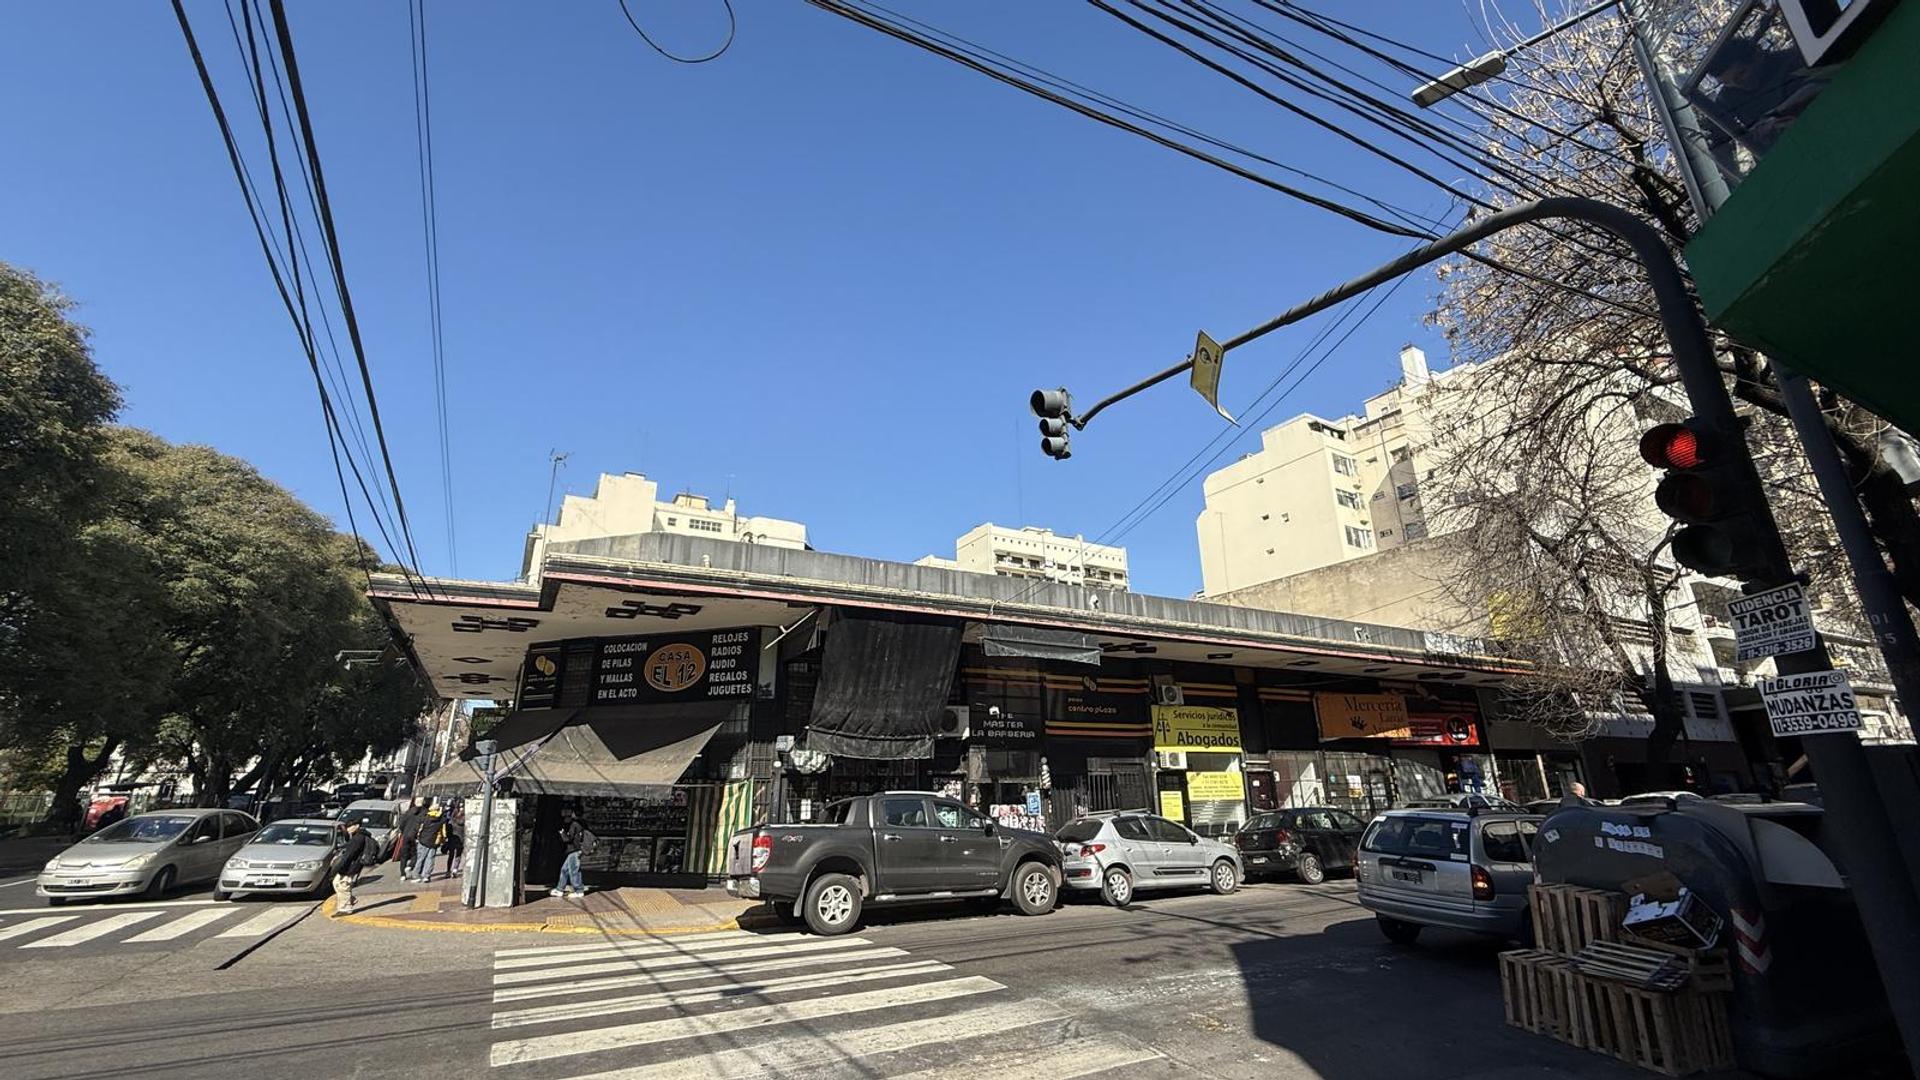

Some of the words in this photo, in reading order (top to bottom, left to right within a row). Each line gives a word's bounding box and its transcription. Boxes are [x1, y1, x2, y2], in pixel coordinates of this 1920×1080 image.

[1731, 588, 1799, 614] VIDENCIA
[1735, 601, 1802, 629] TAROT
[712, 632, 749, 644] RELOJES
[604, 642, 648, 654] COLOCACION
[711, 645, 742, 656] RADIOS
[659, 651, 691, 662] CASA
[602, 659, 611, 669] DE
[612, 658, 632, 668] PILAS
[710, 659, 736, 669] AUDIO
[600, 675, 606, 684] Y
[606, 673, 633, 683] MALLAS
[653, 664, 673, 687] EL
[677, 663, 697, 684] 12
[709, 671, 748, 682] REGALOS
[597, 690, 608, 699] EN
[608, 689, 617, 698] EL
[618, 688, 637, 698] ACTO
[708, 684, 752, 696] JUGUETES
[1766, 692, 1854, 717] MUDANZAS
[1173, 710, 1206, 720] Servicios
[983, 720, 1024, 729] MASTER
[1773, 712, 1859, 733] 11-3539-0496
[972, 729, 984, 737] LA
[988, 730, 1035, 738] BARBERIA
[1177, 731, 1239, 749] Abogados
